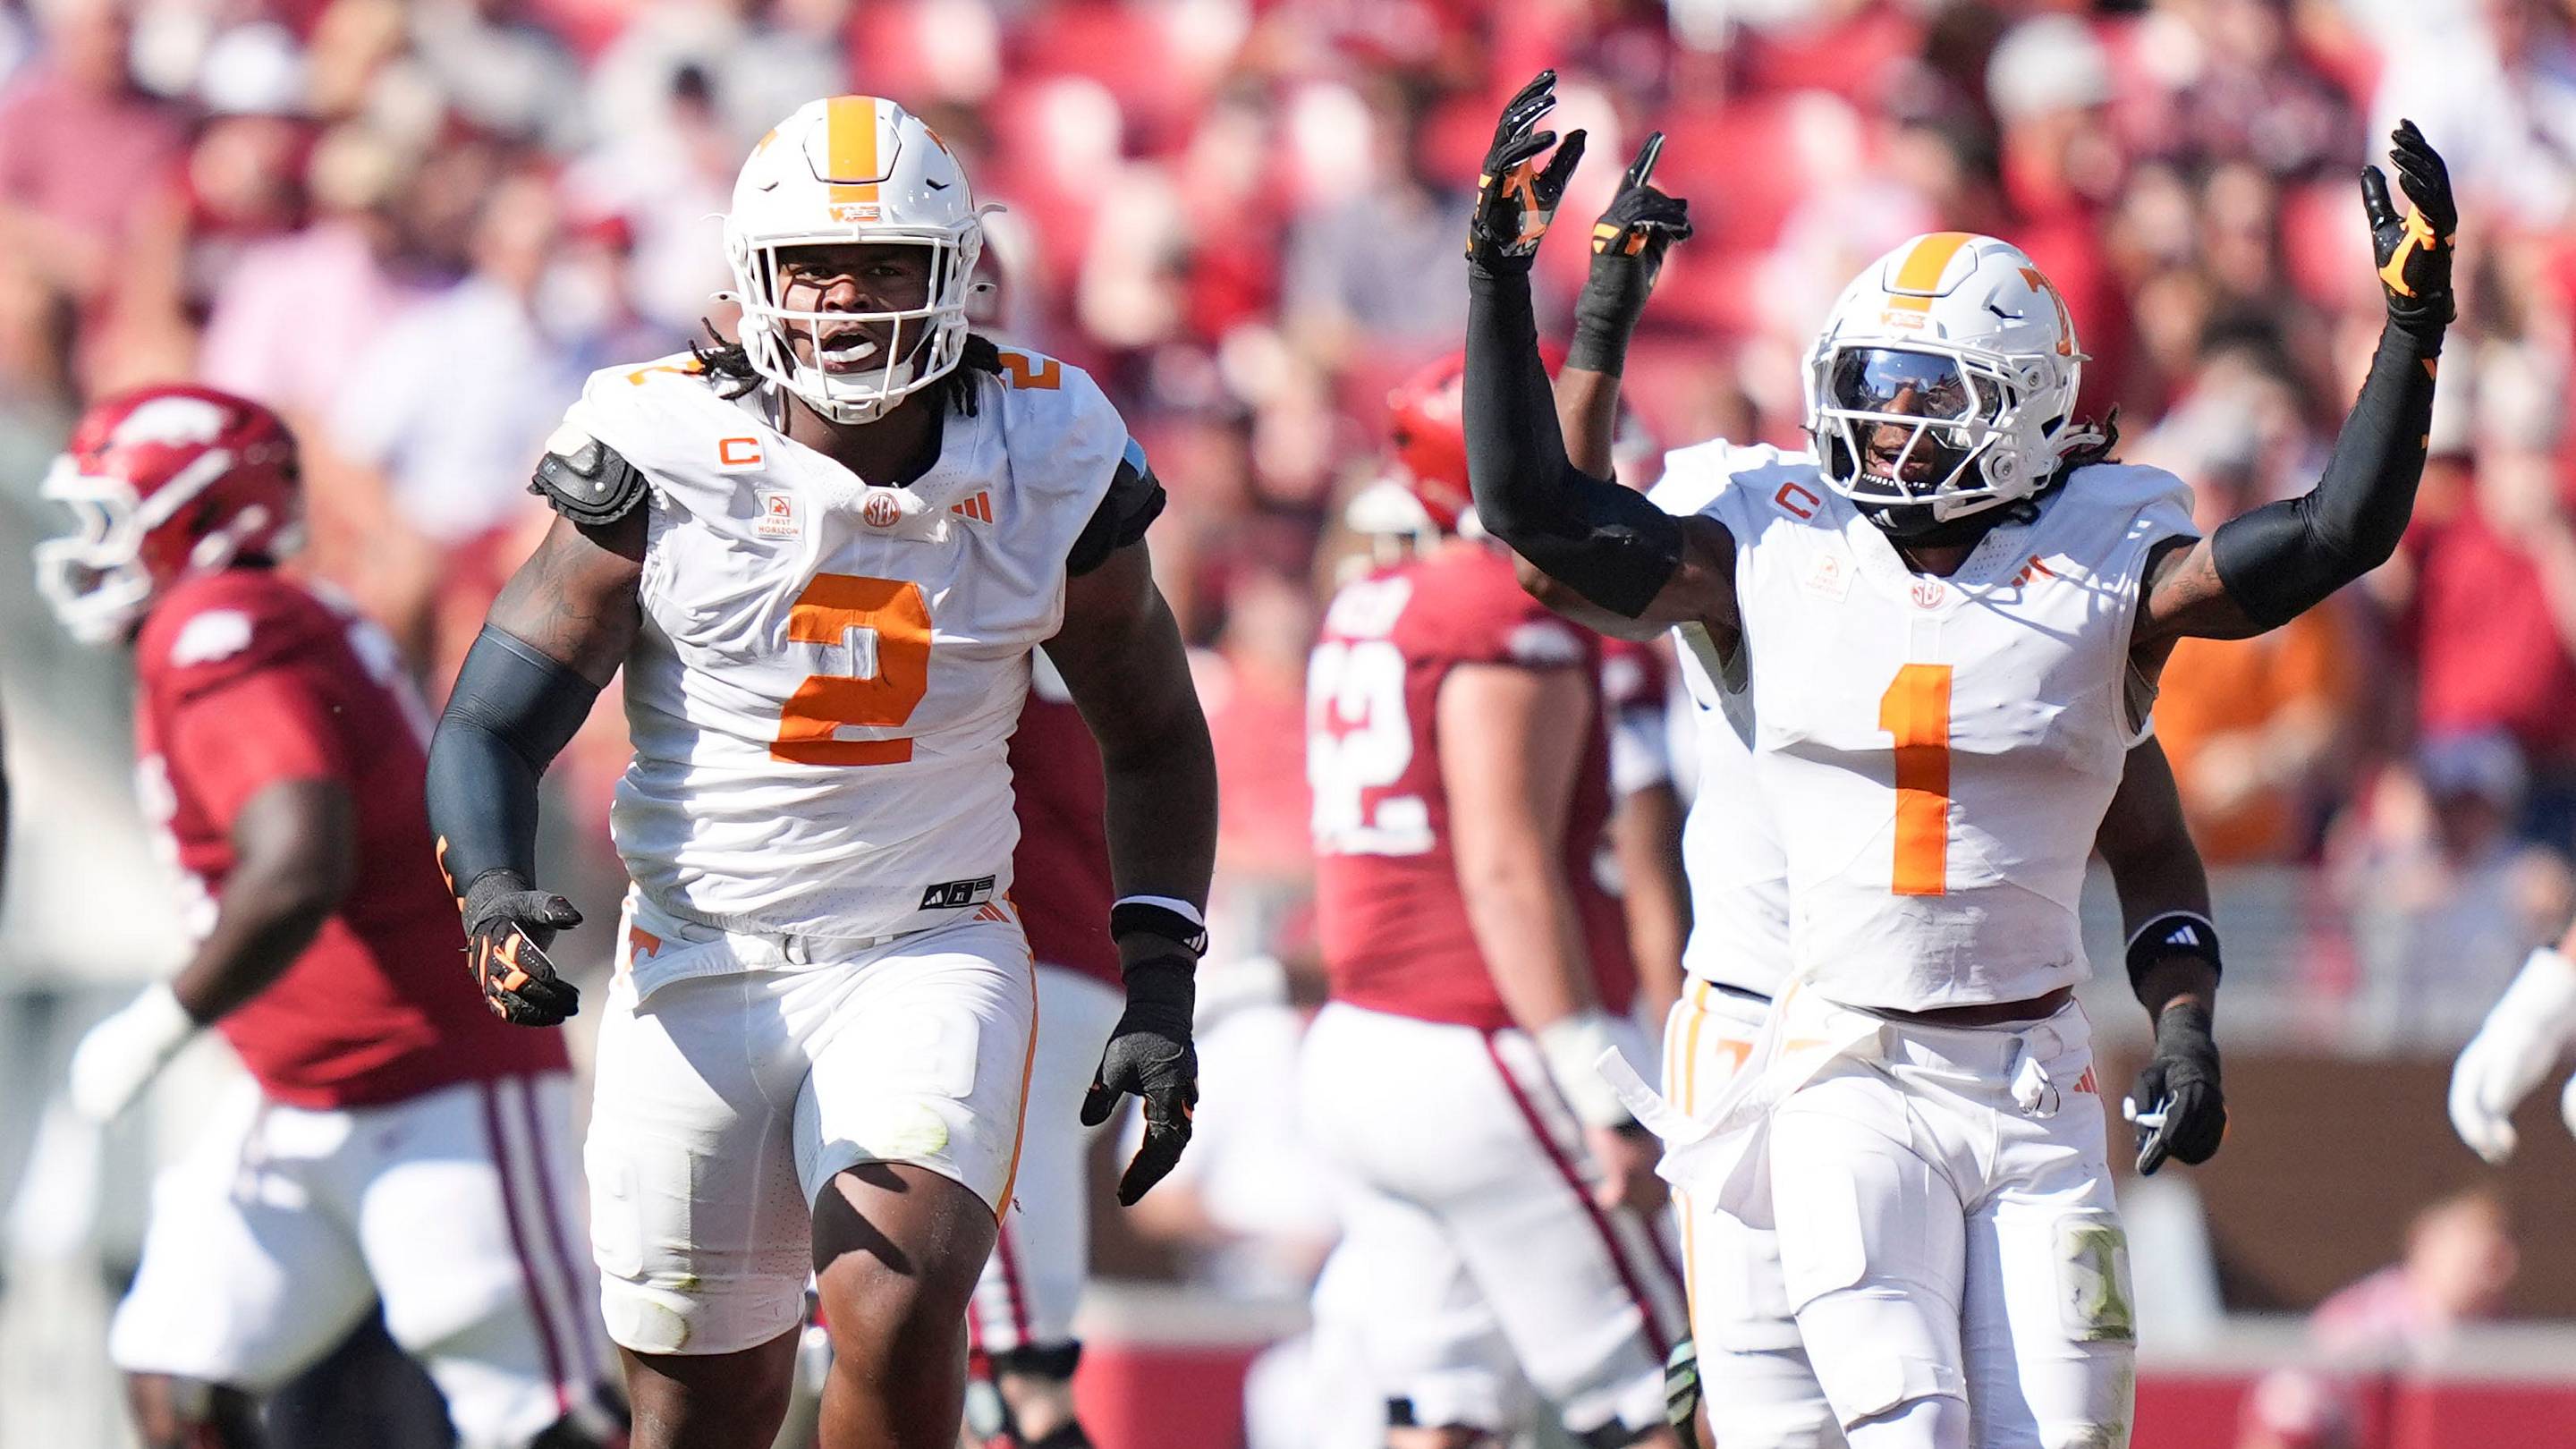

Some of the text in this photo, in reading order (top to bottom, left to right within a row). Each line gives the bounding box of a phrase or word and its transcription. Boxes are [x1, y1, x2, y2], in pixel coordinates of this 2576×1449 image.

[719, 437, 760, 465] C
[865, 493, 901, 527] SEC
[1775, 482, 1820, 519] C
[758, 526, 799, 535] HORIZON
[767, 518, 791, 526] FIRST
[769, 572, 931, 767] 2
[1878, 664, 1953, 895] 1
